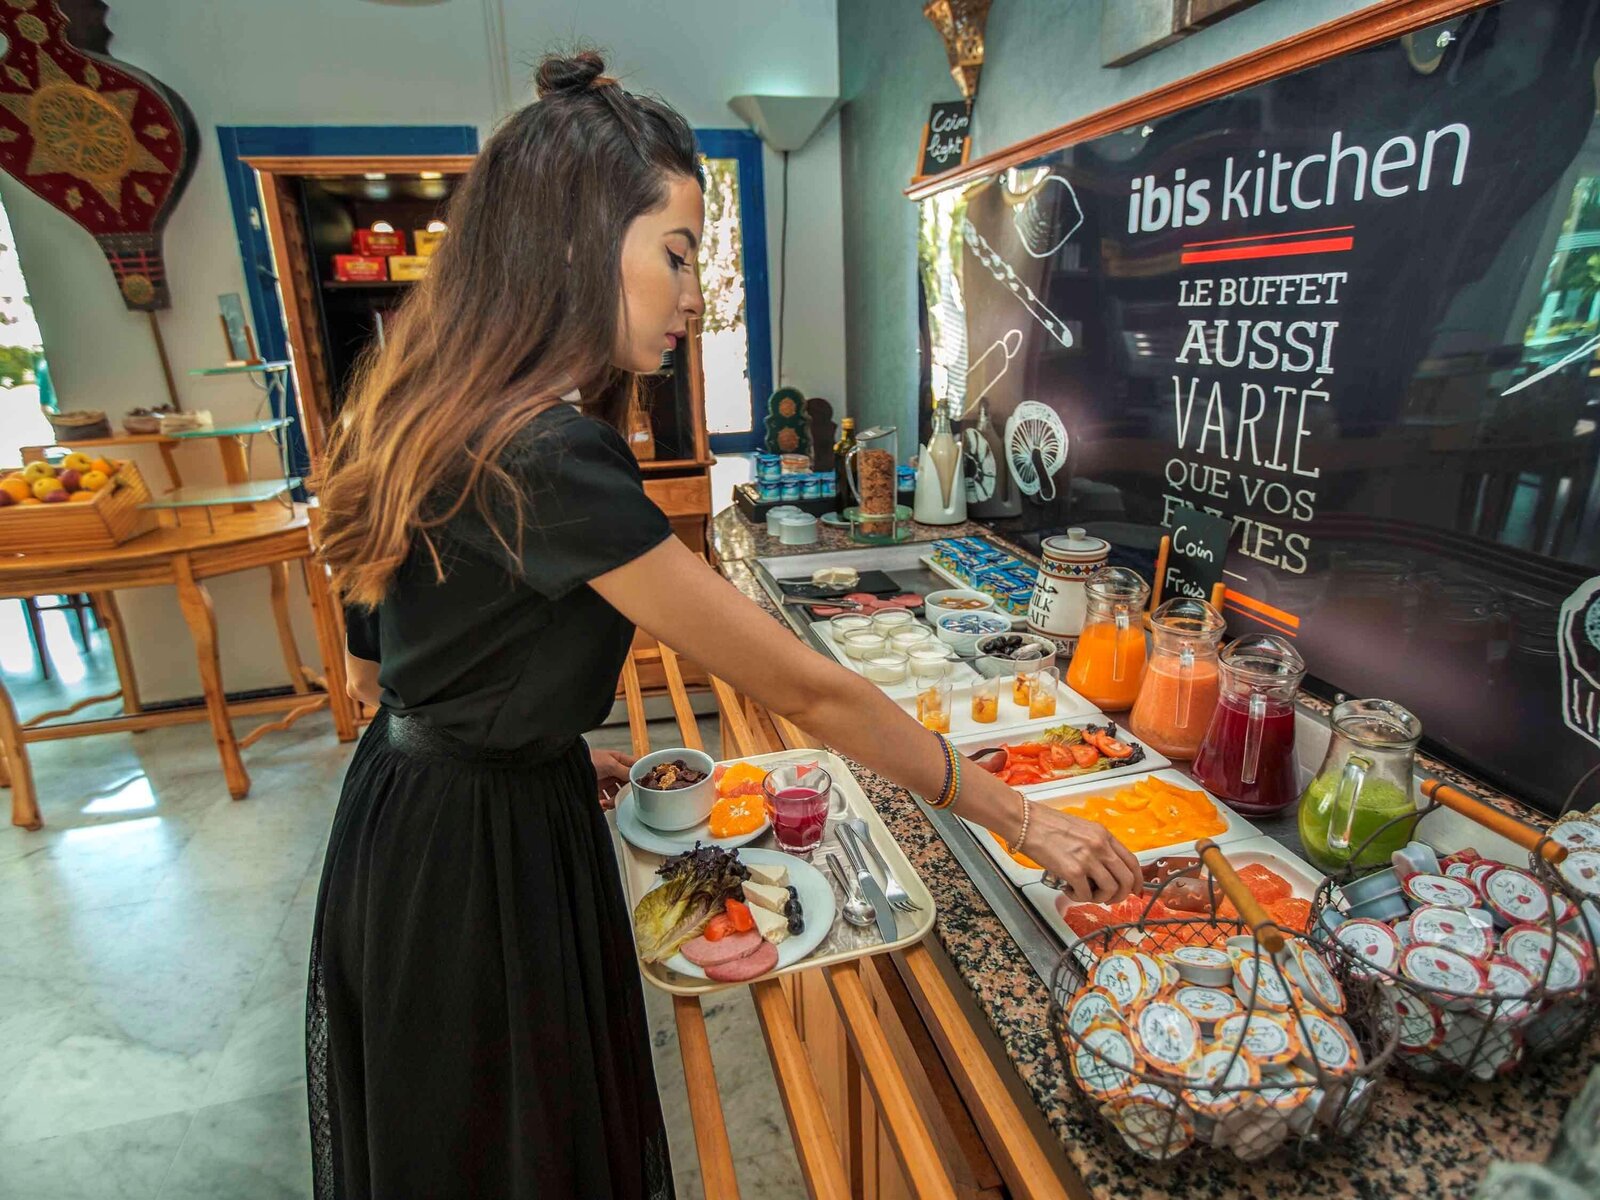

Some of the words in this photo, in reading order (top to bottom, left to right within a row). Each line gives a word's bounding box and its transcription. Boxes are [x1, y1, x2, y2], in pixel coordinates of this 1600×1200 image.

[931, 109, 969, 132] Coin
[1128, 168, 1211, 233] ibis
[1221, 122, 1471, 221] kitchen
[1177, 280, 1213, 307] LE
[1218, 272, 1348, 305] BUFFET
[1175, 320, 1339, 374] AUSSI
[1171, 375, 1330, 478] VARIÉ
[1164, 458, 1231, 499] QUE
[1239, 474, 1317, 523] VOS
[1173, 525, 1214, 563] Coin
[1165, 567, 1206, 599] Frais
